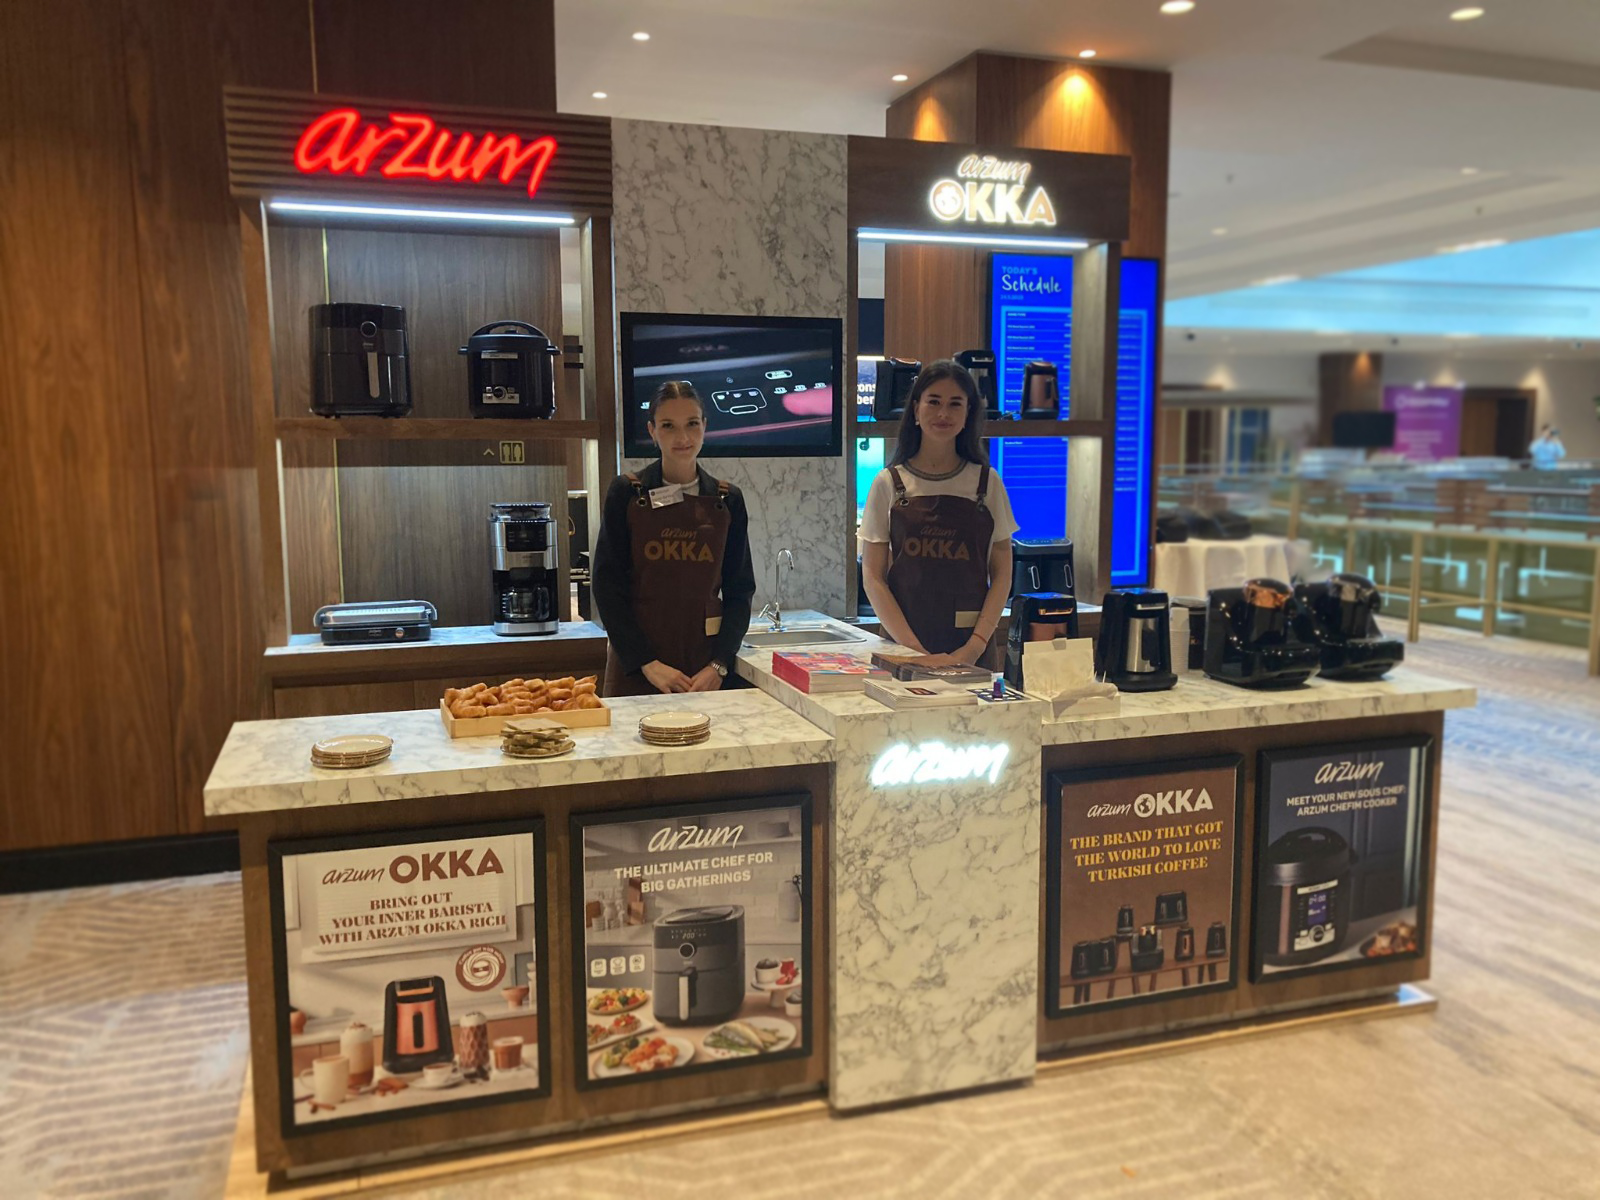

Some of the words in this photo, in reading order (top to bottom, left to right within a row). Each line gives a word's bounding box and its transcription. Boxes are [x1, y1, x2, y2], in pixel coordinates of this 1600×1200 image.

[293, 107, 558, 199] arzum
[957, 154, 1032, 185] arzum
[930, 179, 1057, 225] OKKA
[1002, 274, 1062, 294] Schedule
[644, 541, 715, 562] OKKA
[904, 537, 970, 561] OKKA
[870, 740, 1010, 786] arzum
[1314, 761, 1384, 784] arzum
[1087, 802, 1131, 818] arzum
[1133, 788, 1214, 818] OKKA
[1286, 796, 1310, 807] MEET
[1311, 793, 1335, 804] YOUR
[1337, 790, 1357, 801] NEW
[1358, 788, 1381, 799] SOUS
[1297, 804, 1329, 817] ARZUM
[1363, 796, 1398, 808] COOKER
[648, 825, 744, 852] arzum
[1070, 836, 1100, 850] THE
[1103, 830, 1152, 845] BRAND
[1155, 825, 1192, 839] THAT
[1195, 821, 1224, 835] GOT
[614, 866, 641, 880] THE
[644, 859, 709, 876] ULTIMATE
[711, 855, 745, 868] CHEF
[747, 852, 773, 865] FOR
[1075, 853, 1105, 867] THE
[1108, 847, 1161, 863] WORLD
[1163, 843, 1183, 856] TO
[1185, 838, 1221, 853] LOVE
[322, 866, 385, 885] arzum
[389, 848, 504, 884] OKKA
[1088, 863, 1152, 883] TURKISH
[1154, 856, 1209, 875] COFFEE
[641, 880, 664, 893] BIG
[666, 870, 751, 889] GATHERINGS
[370, 895, 418, 911] BRING
[421, 892, 453, 905] OUT
[331, 913, 375, 929] YOUR
[379, 909, 426, 925] INNER
[429, 902, 493, 919] BARISTA
[319, 930, 363, 945] WITH
[366, 924, 420, 940] ARZUM
[423, 919, 467, 934] OKKA
[469, 914, 506, 929] RICH
